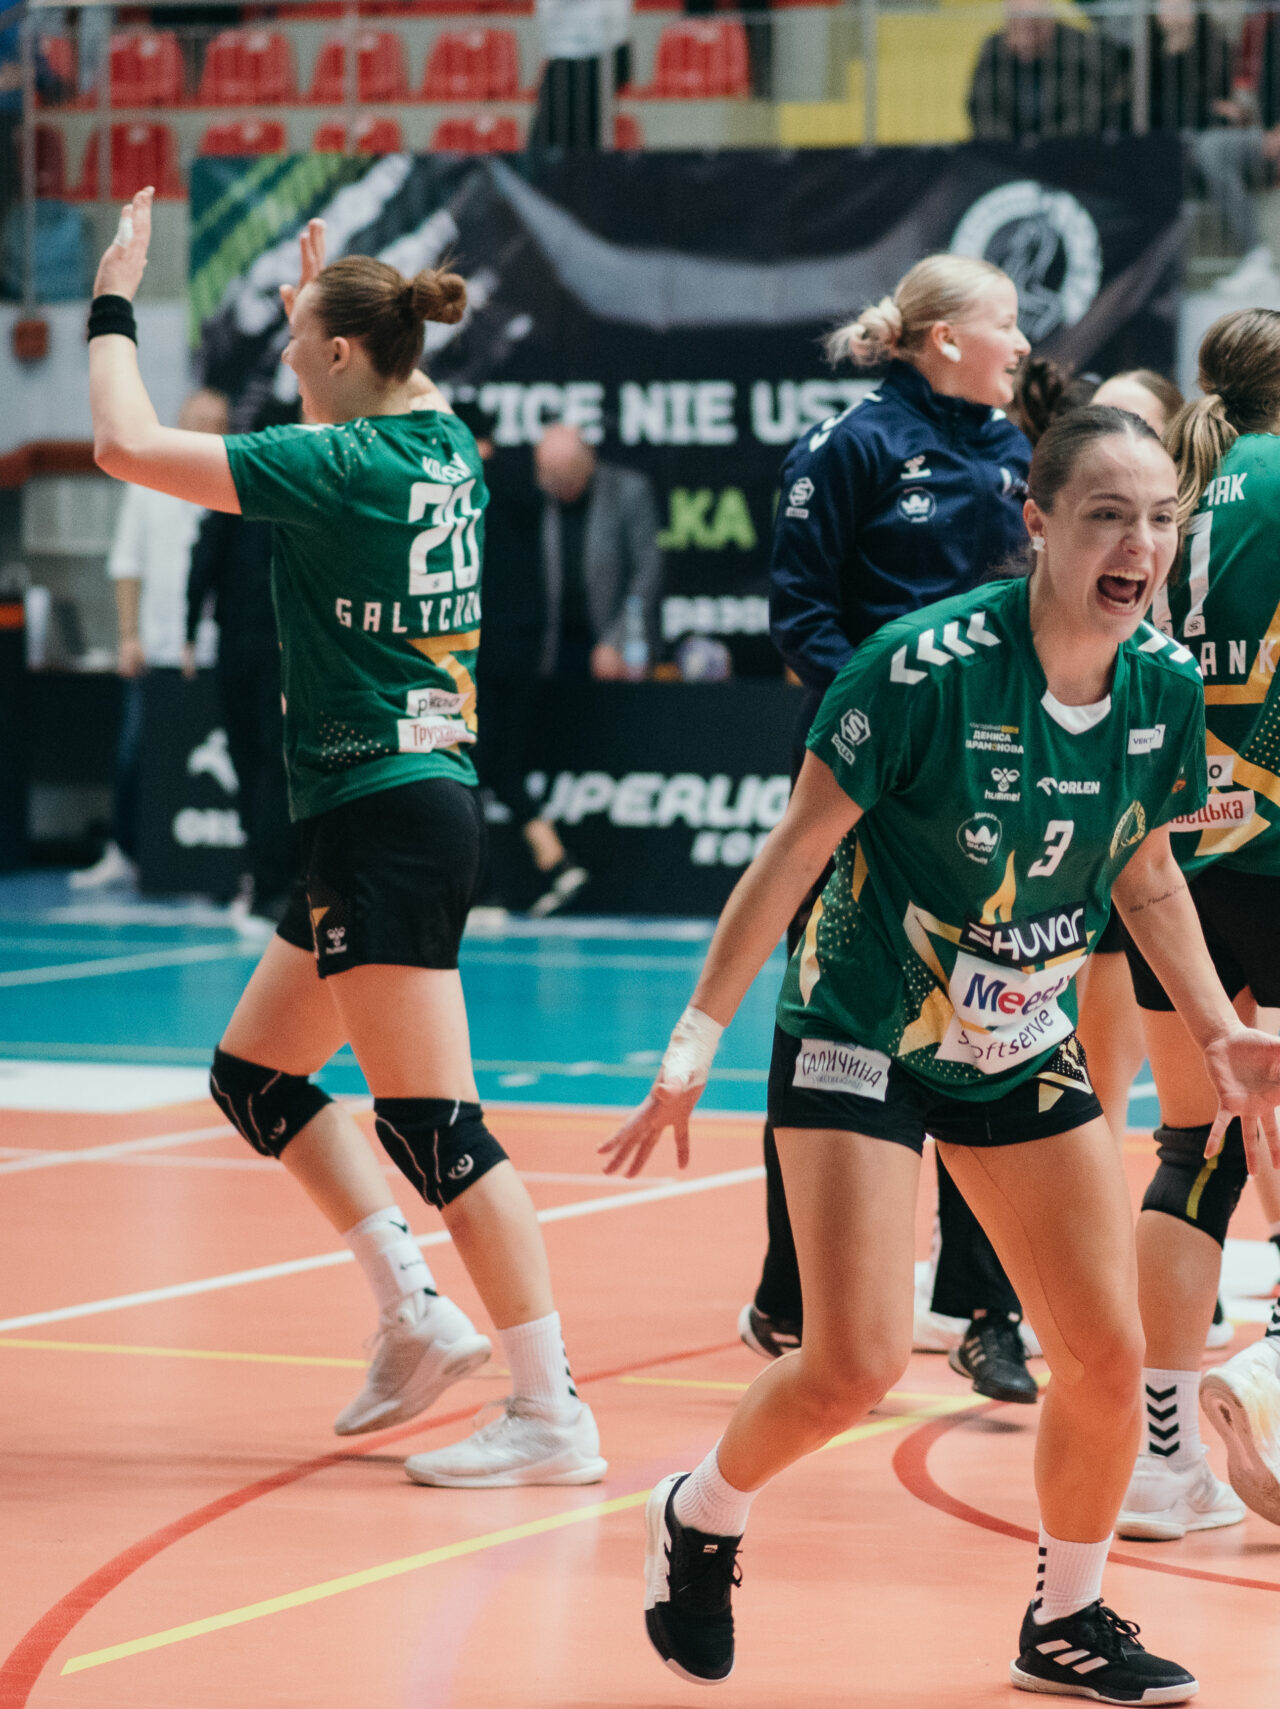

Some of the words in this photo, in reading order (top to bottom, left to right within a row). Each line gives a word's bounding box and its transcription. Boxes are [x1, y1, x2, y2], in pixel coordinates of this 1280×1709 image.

[619, 380, 736, 445] NIE
[408, 478, 481, 596] 20
[984, 789, 1020, 802] hummel
[1059, 781, 1100, 794] ORLEN
[1027, 819, 1075, 878] 3
[802, 1049, 882, 1088] ГАЛИЧИНА
